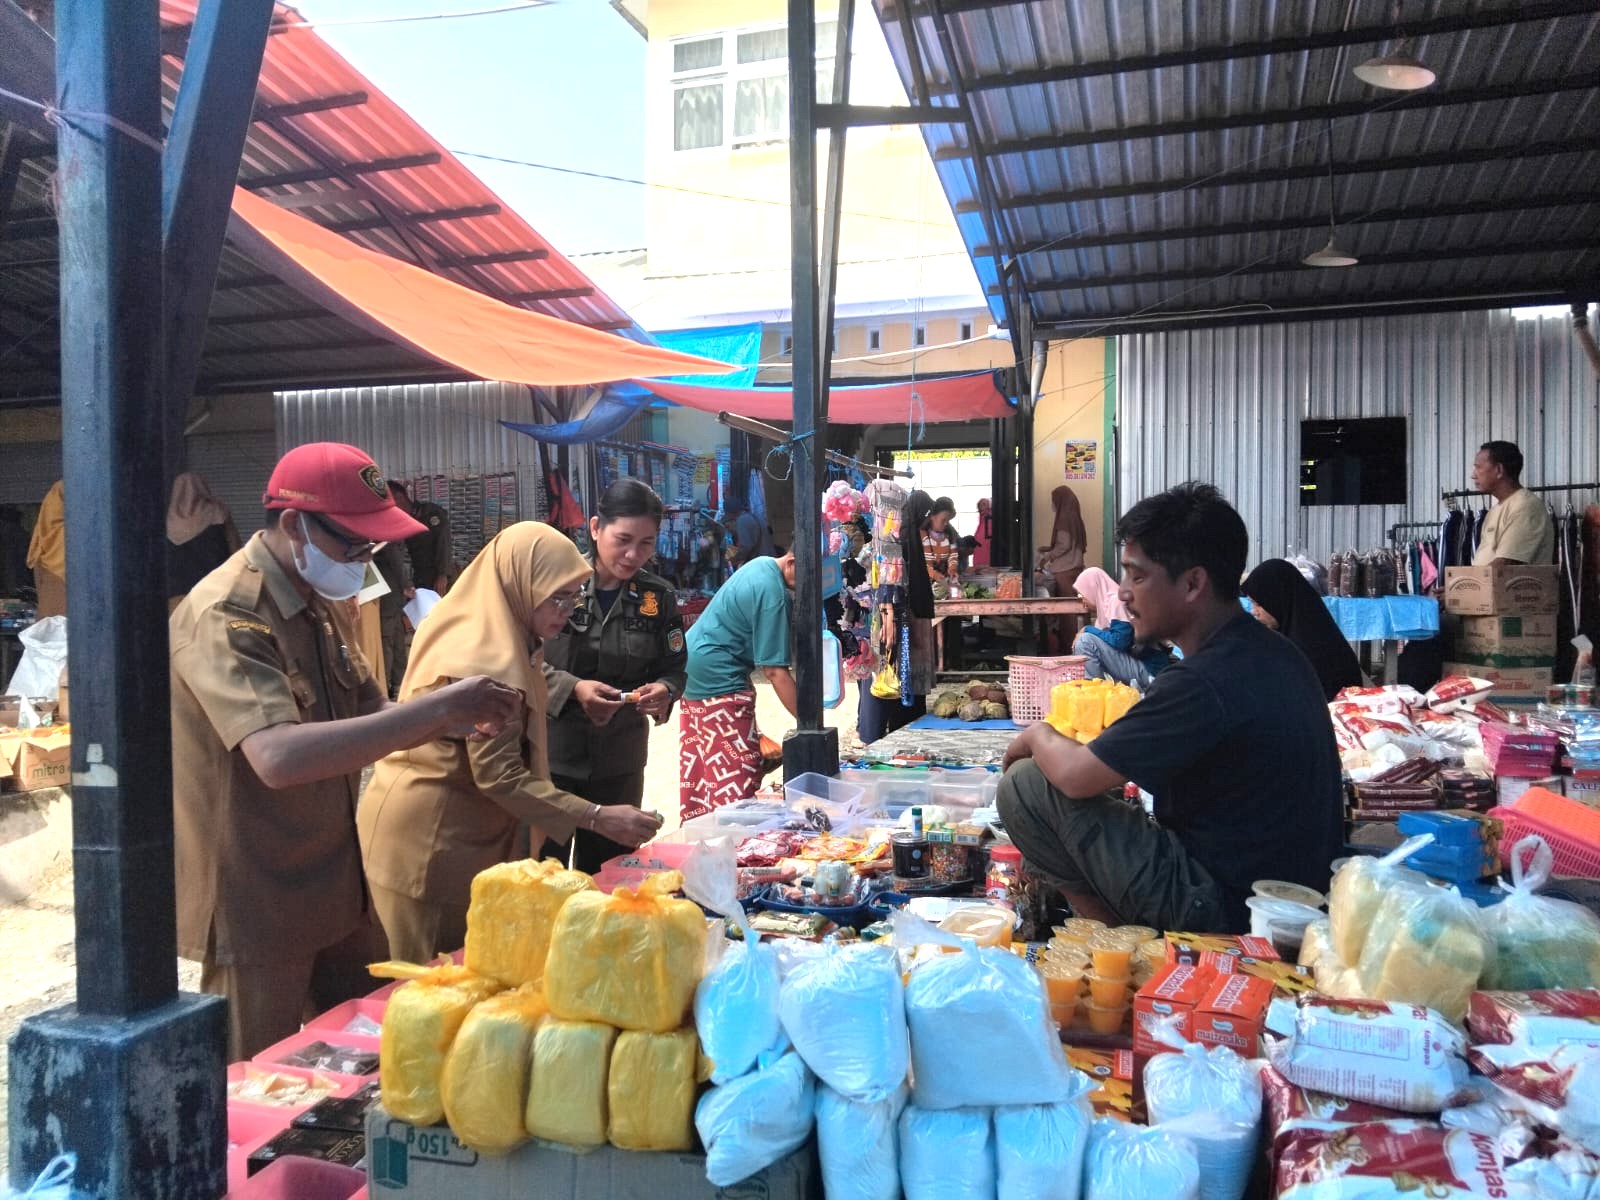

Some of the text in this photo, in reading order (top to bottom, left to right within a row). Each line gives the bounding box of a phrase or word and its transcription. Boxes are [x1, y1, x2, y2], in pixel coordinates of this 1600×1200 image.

[32, 763, 65, 779] mitra
[1195, 1029, 1247, 1047] maizenaku
[419, 1133, 449, 1156] 150
[1468, 1131, 1508, 1200] Kompas
